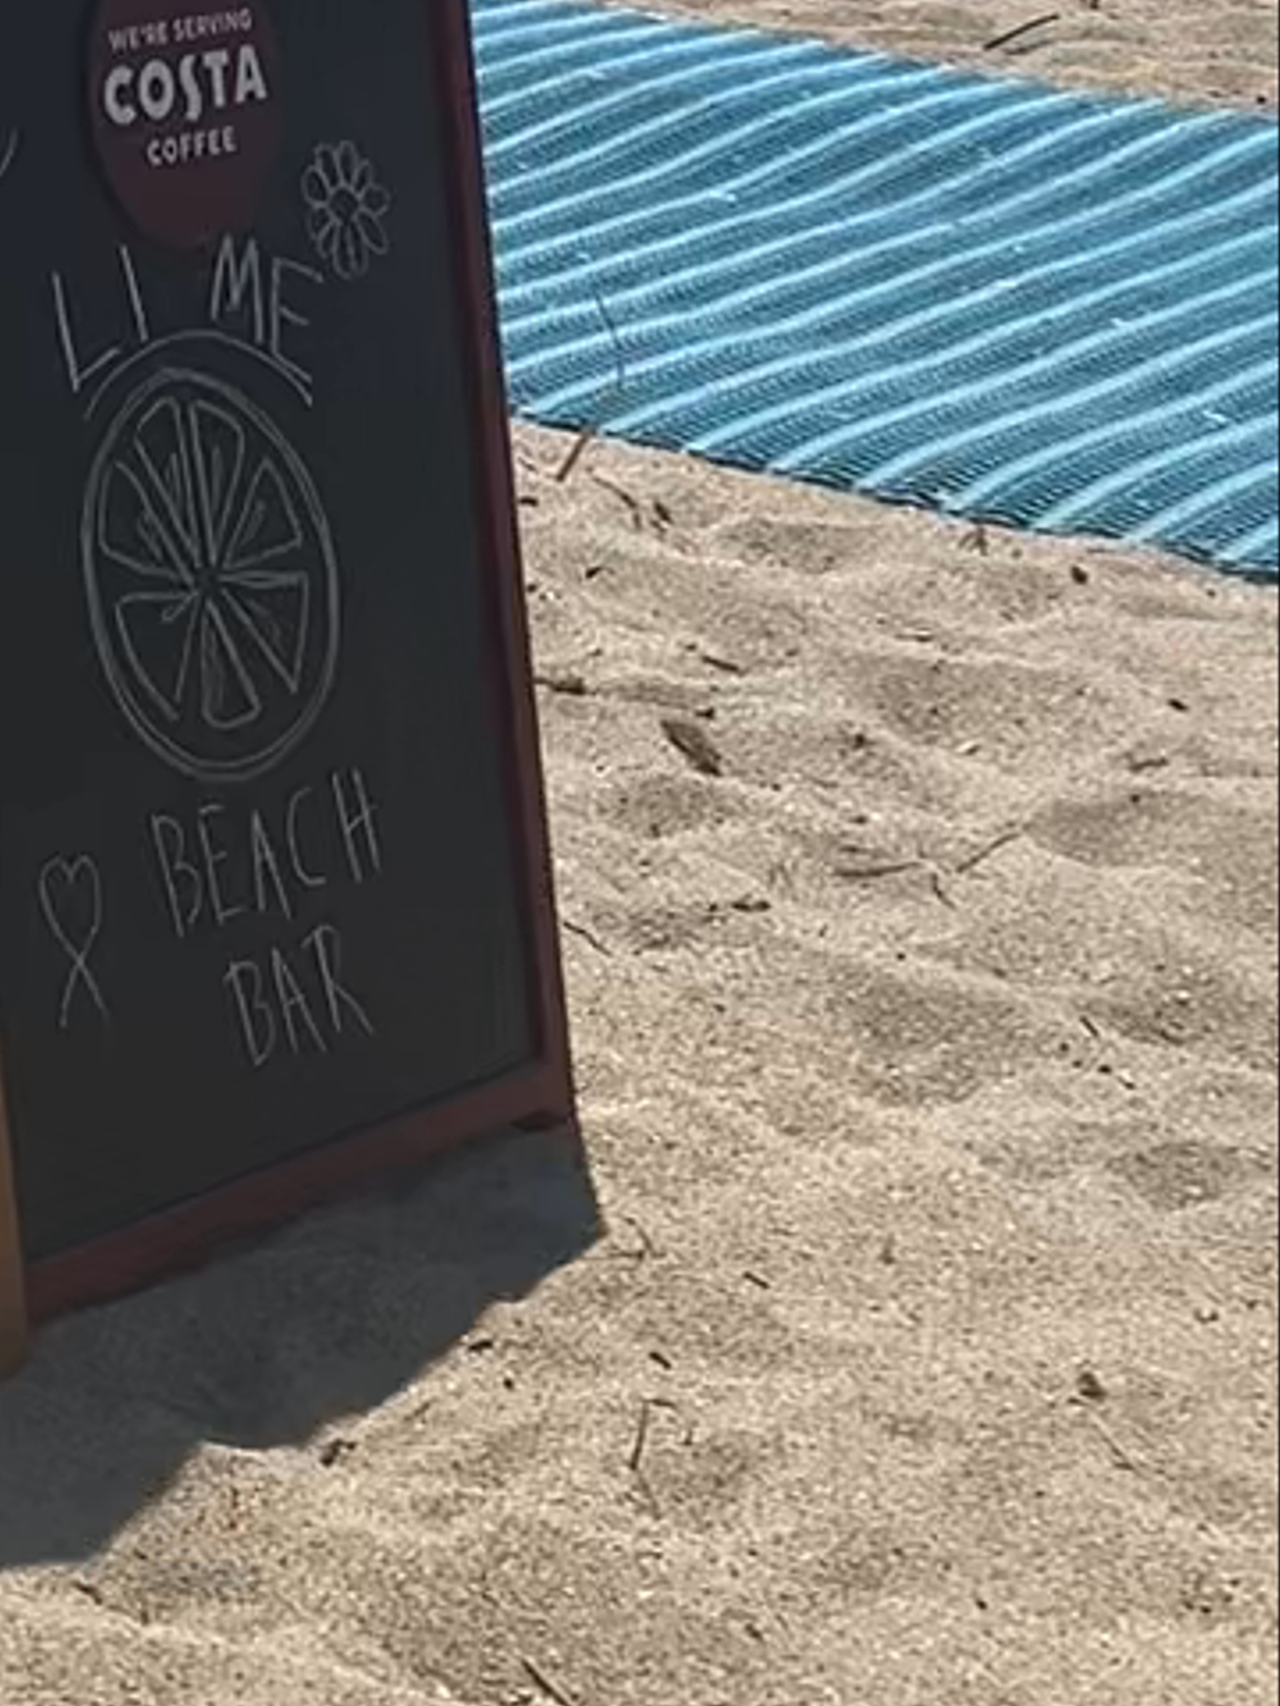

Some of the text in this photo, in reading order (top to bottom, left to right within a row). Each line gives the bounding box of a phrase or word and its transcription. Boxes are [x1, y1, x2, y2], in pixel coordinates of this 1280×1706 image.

[108, 7, 254, 52] WE'RE SERVING
[103, 43, 268, 126] COSTA
[146, 125, 238, 167] COFFEE
[151, 767, 382, 939] BEACH
[223, 924, 375, 1068] BAR
